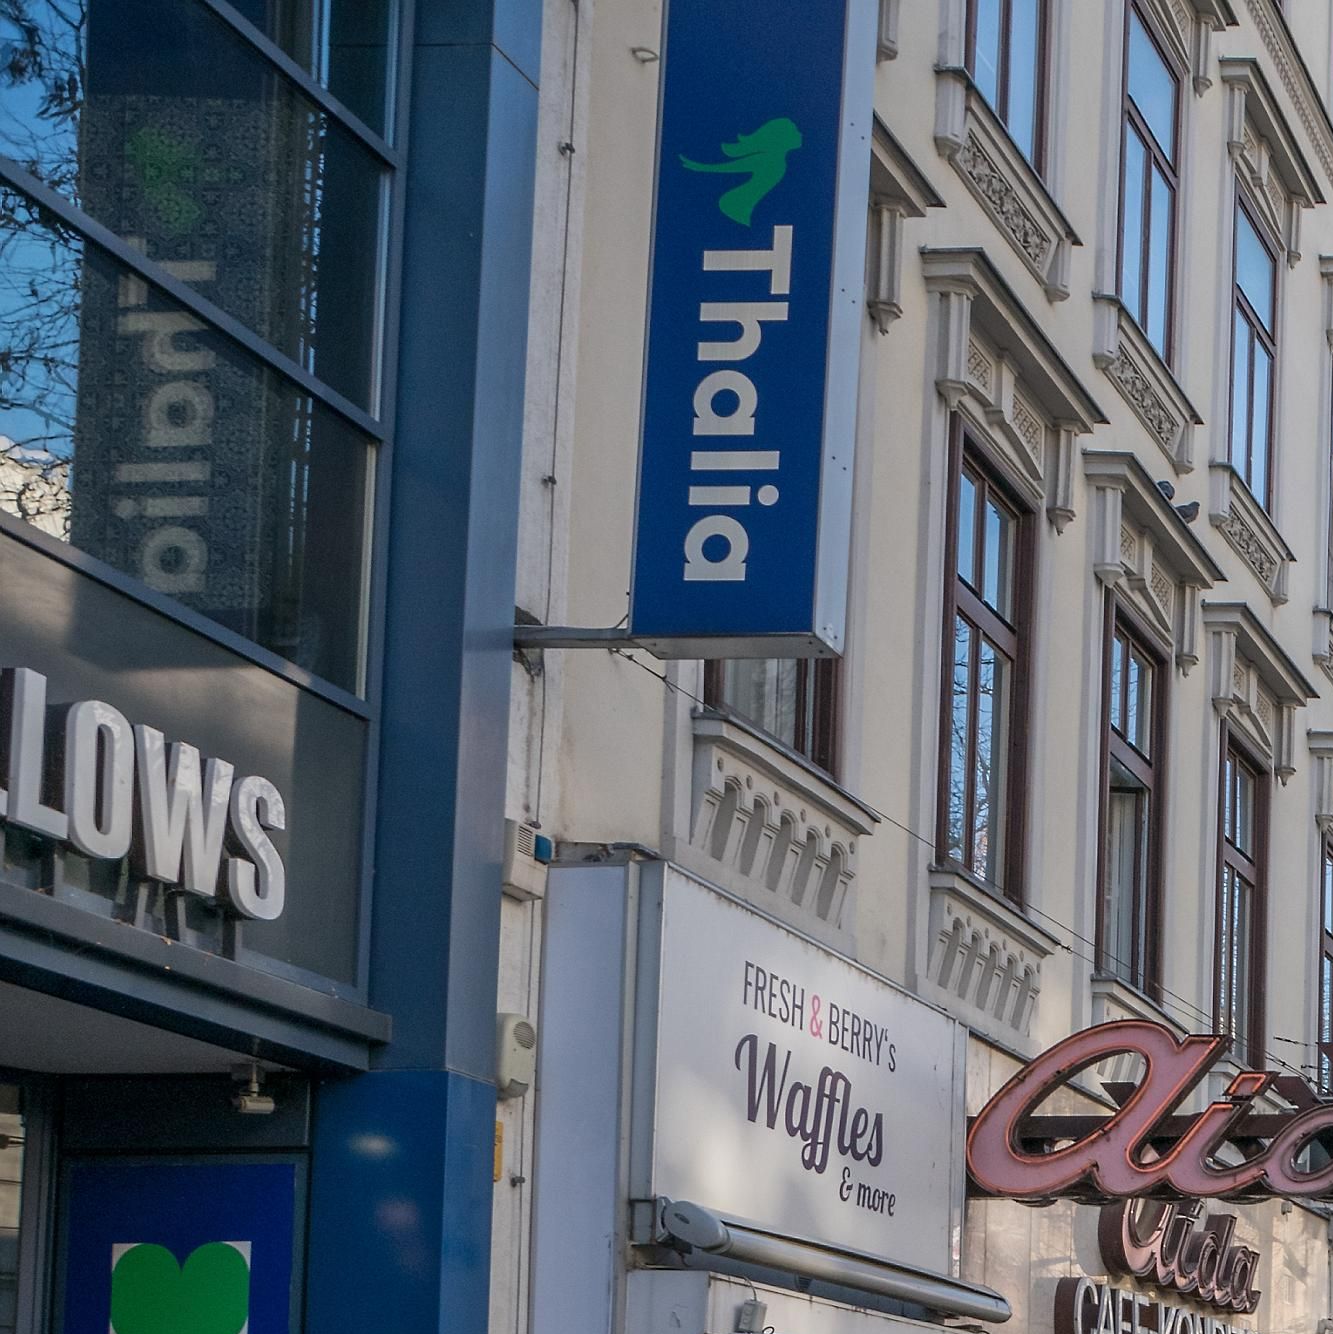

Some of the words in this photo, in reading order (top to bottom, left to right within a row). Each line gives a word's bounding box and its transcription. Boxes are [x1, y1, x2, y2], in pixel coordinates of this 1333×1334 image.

[683, 225, 794, 583] Thalia
[0, 667, 287, 921] LOWS
[743, 960, 806, 1031] FRESH
[809, 995, 823, 1039] &
[735, 1033, 884, 1174] Waffles
[839, 1166, 854, 1202] &
[856, 1179, 896, 1218] more
